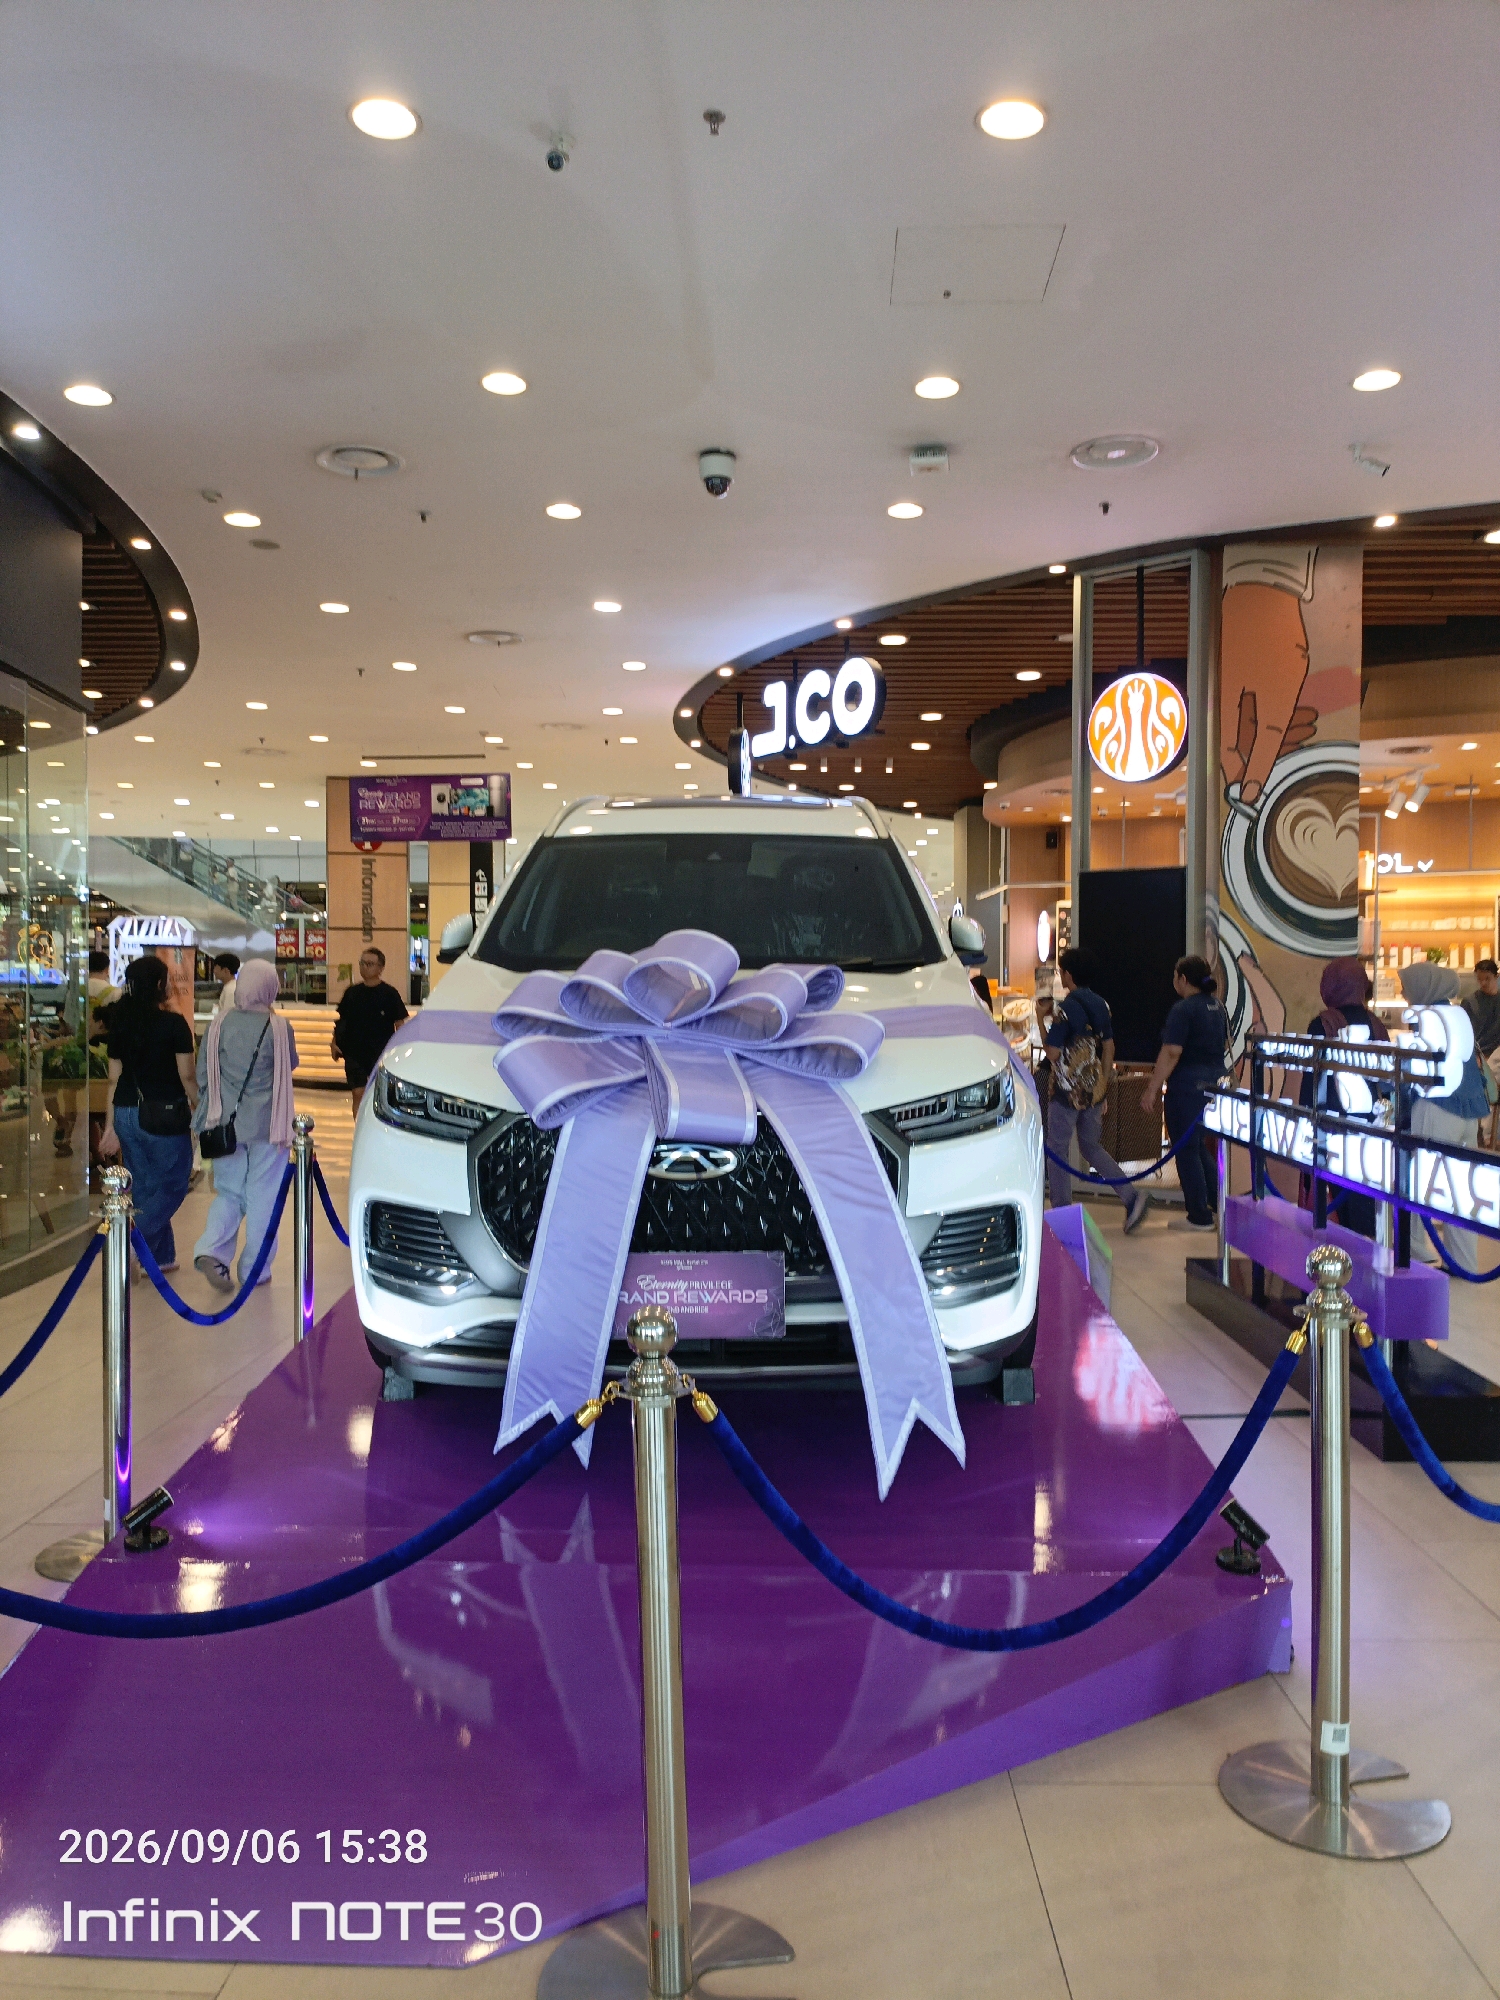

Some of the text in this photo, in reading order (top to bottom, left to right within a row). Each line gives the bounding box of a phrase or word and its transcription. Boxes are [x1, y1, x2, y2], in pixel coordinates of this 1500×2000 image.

[752, 657, 876, 757] J.CO
[359, 799, 422, 810] REWARDS
[361, 858, 377, 943] Information
[689, 1279, 734, 1290] PRIVILEGE
[674, 1289, 768, 1304] REWARDS
